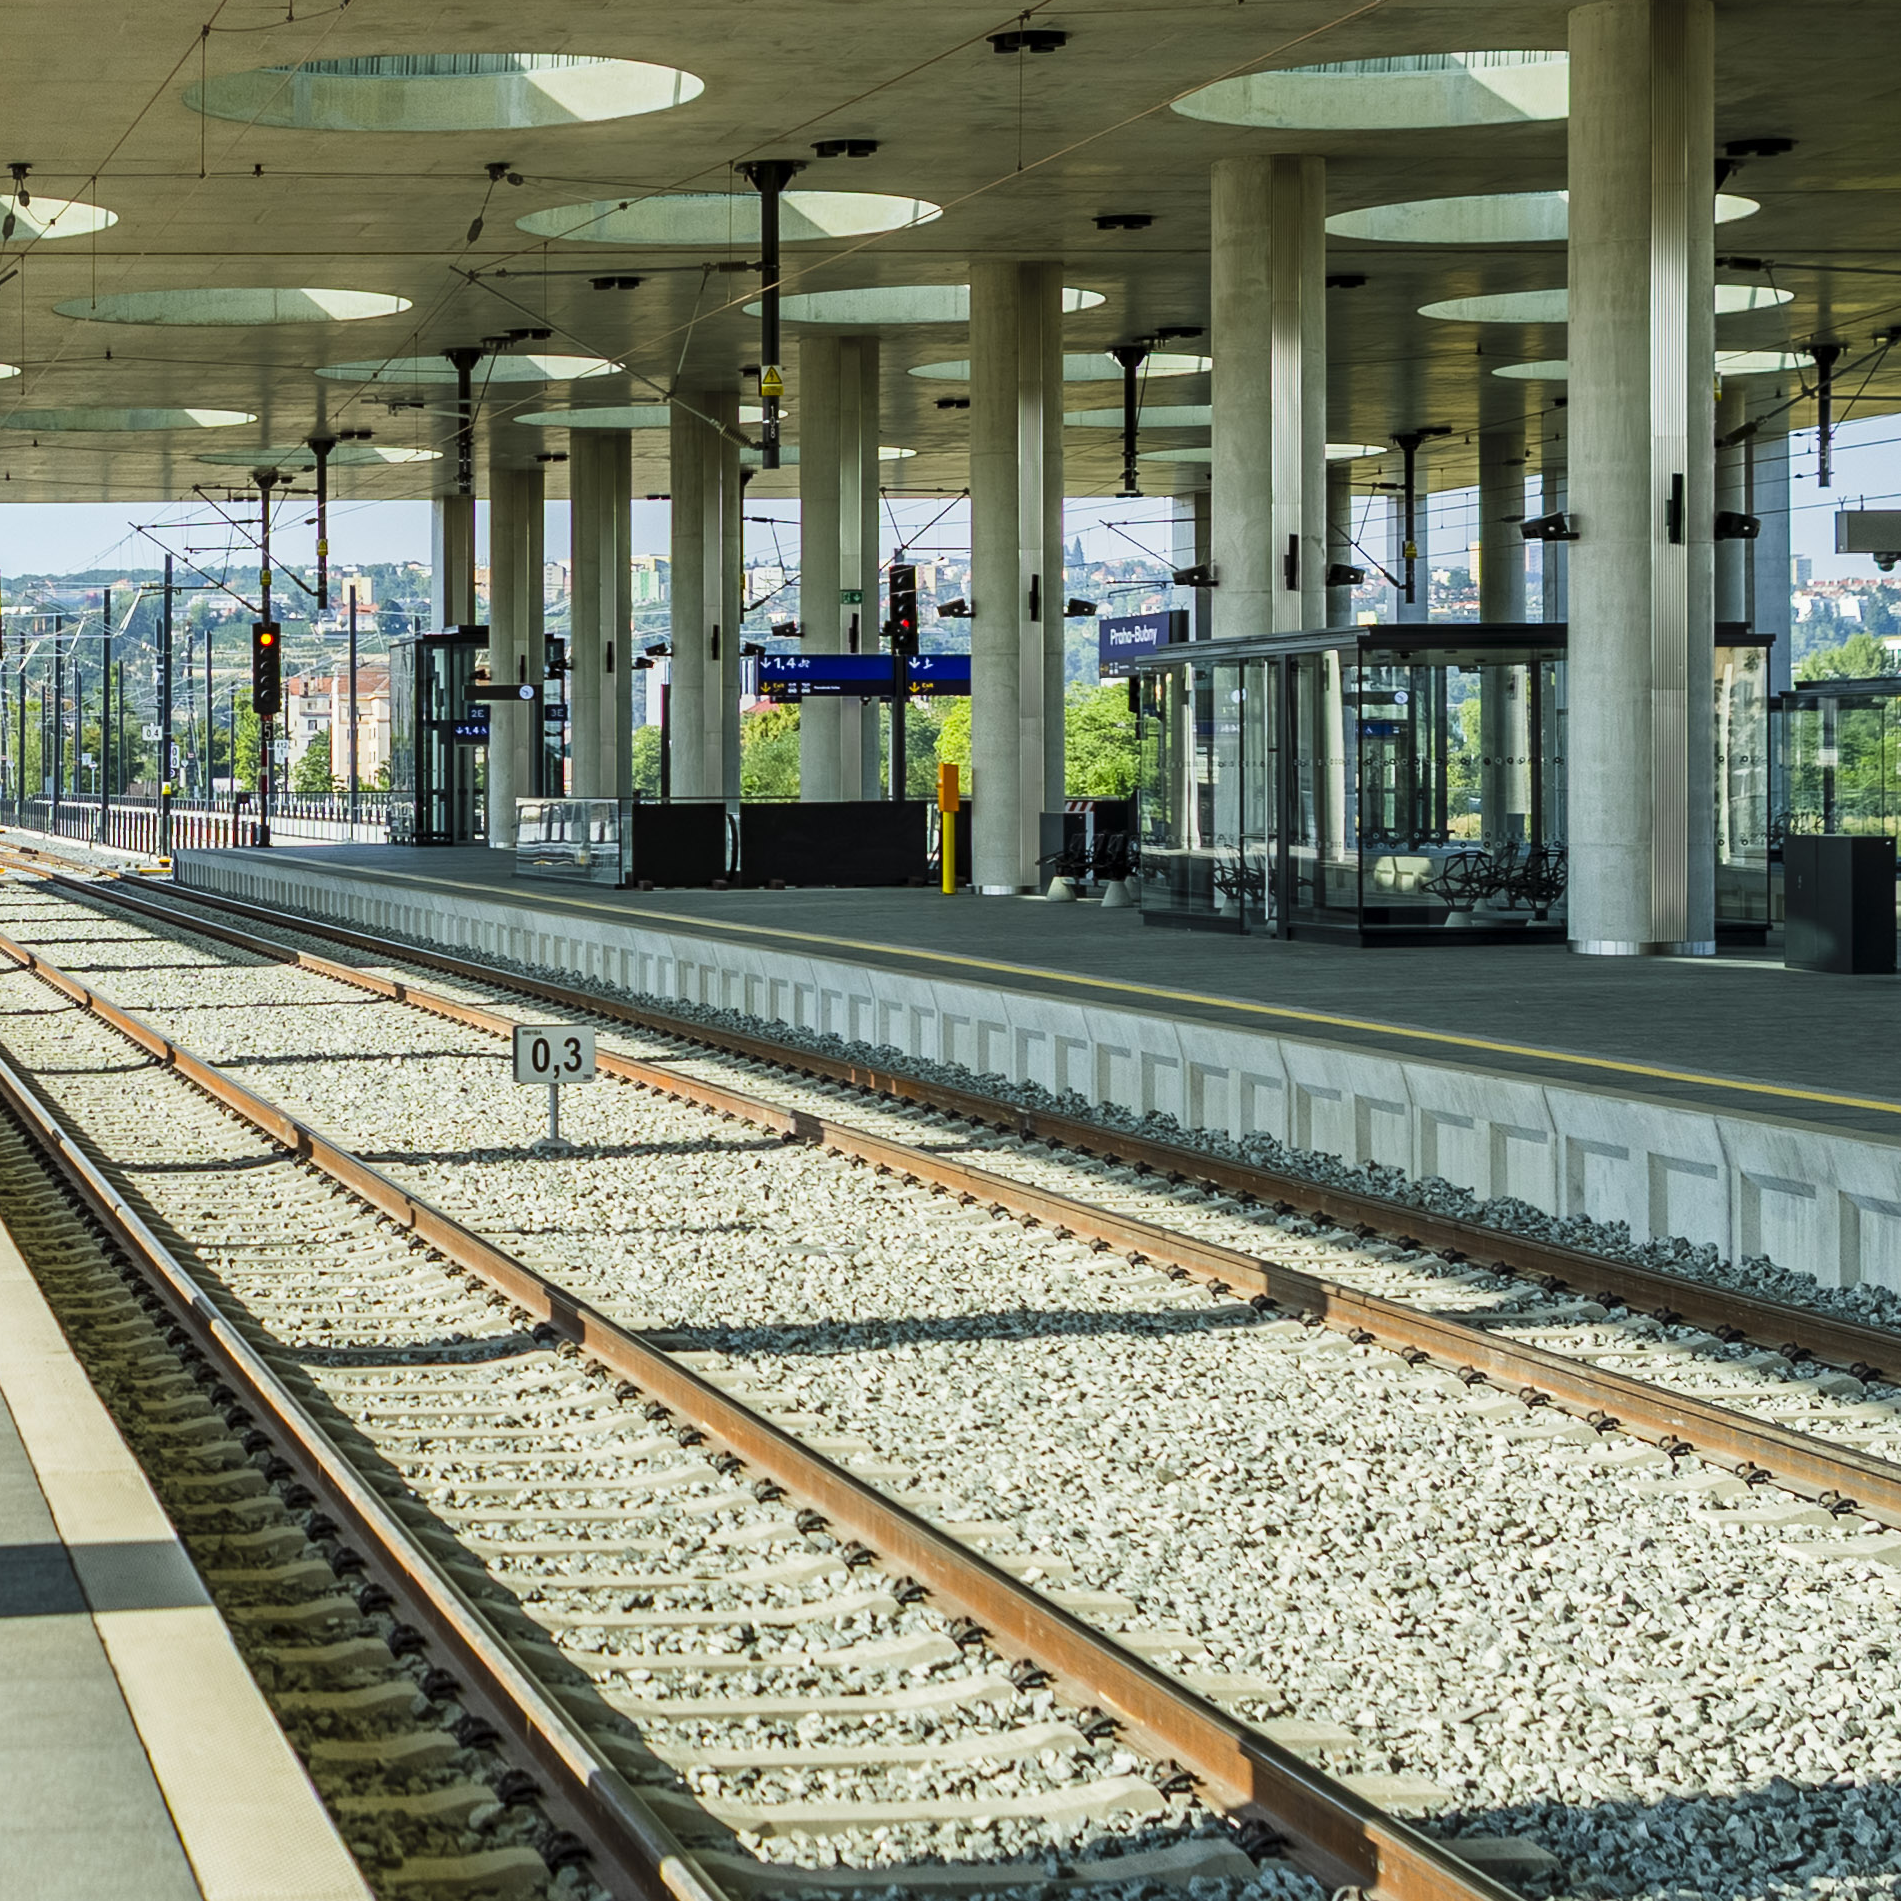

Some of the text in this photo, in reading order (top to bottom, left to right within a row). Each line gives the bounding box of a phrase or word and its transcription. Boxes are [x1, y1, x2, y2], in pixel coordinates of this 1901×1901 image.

[1110, 624, 1158, 646] Praha-Bubny
[773, 657, 797, 670] 1,4
[471, 709, 485, 718] 2E
[550, 708, 564, 717] 3E
[264, 723, 271, 740] 5
[532, 1036, 583, 1080] 0,3
